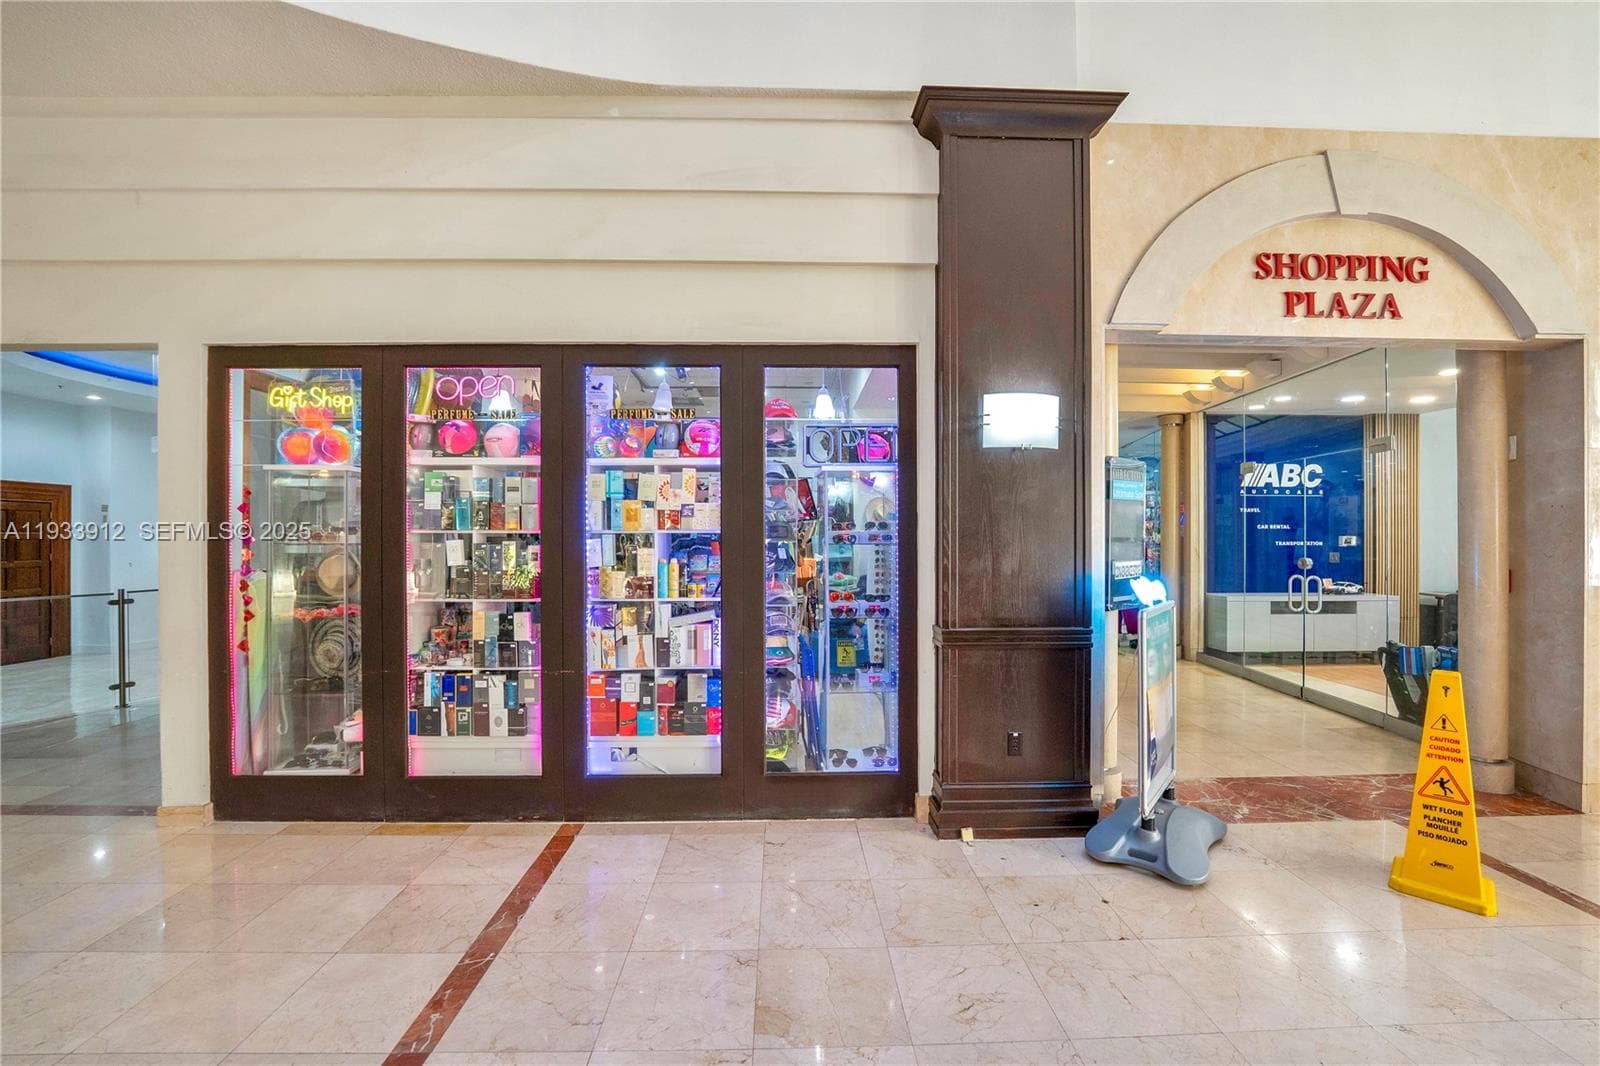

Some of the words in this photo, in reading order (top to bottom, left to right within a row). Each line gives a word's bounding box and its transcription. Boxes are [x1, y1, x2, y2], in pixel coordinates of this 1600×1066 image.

[1255, 252, 1430, 284] SHOPPING
[1283, 291, 1403, 319] PLAZA
[436, 375, 515, 406] open
[269, 386, 307, 413] Gift
[309, 386, 354, 414] Shop
[431, 408, 475, 420] PERFUME
[610, 408, 655, 420] PERFUME
[671, 408, 696, 419] SALE
[1257, 463, 1324, 488] ABC
[1429, 736, 1460, 745] CAUTION
[1429, 744, 1461, 754] CUIDADO
[1426, 753, 1464, 764] ATTENTION
[1422, 803, 1438, 812] WET
[1439, 807, 1464, 817] FLOOR
[1423, 814, 1462, 828] PLANCHER
[1426, 822, 1460, 834] MOUILLÉ
[1417, 829, 1434, 839] PISO
[1435, 834, 1468, 847] MOJADO
